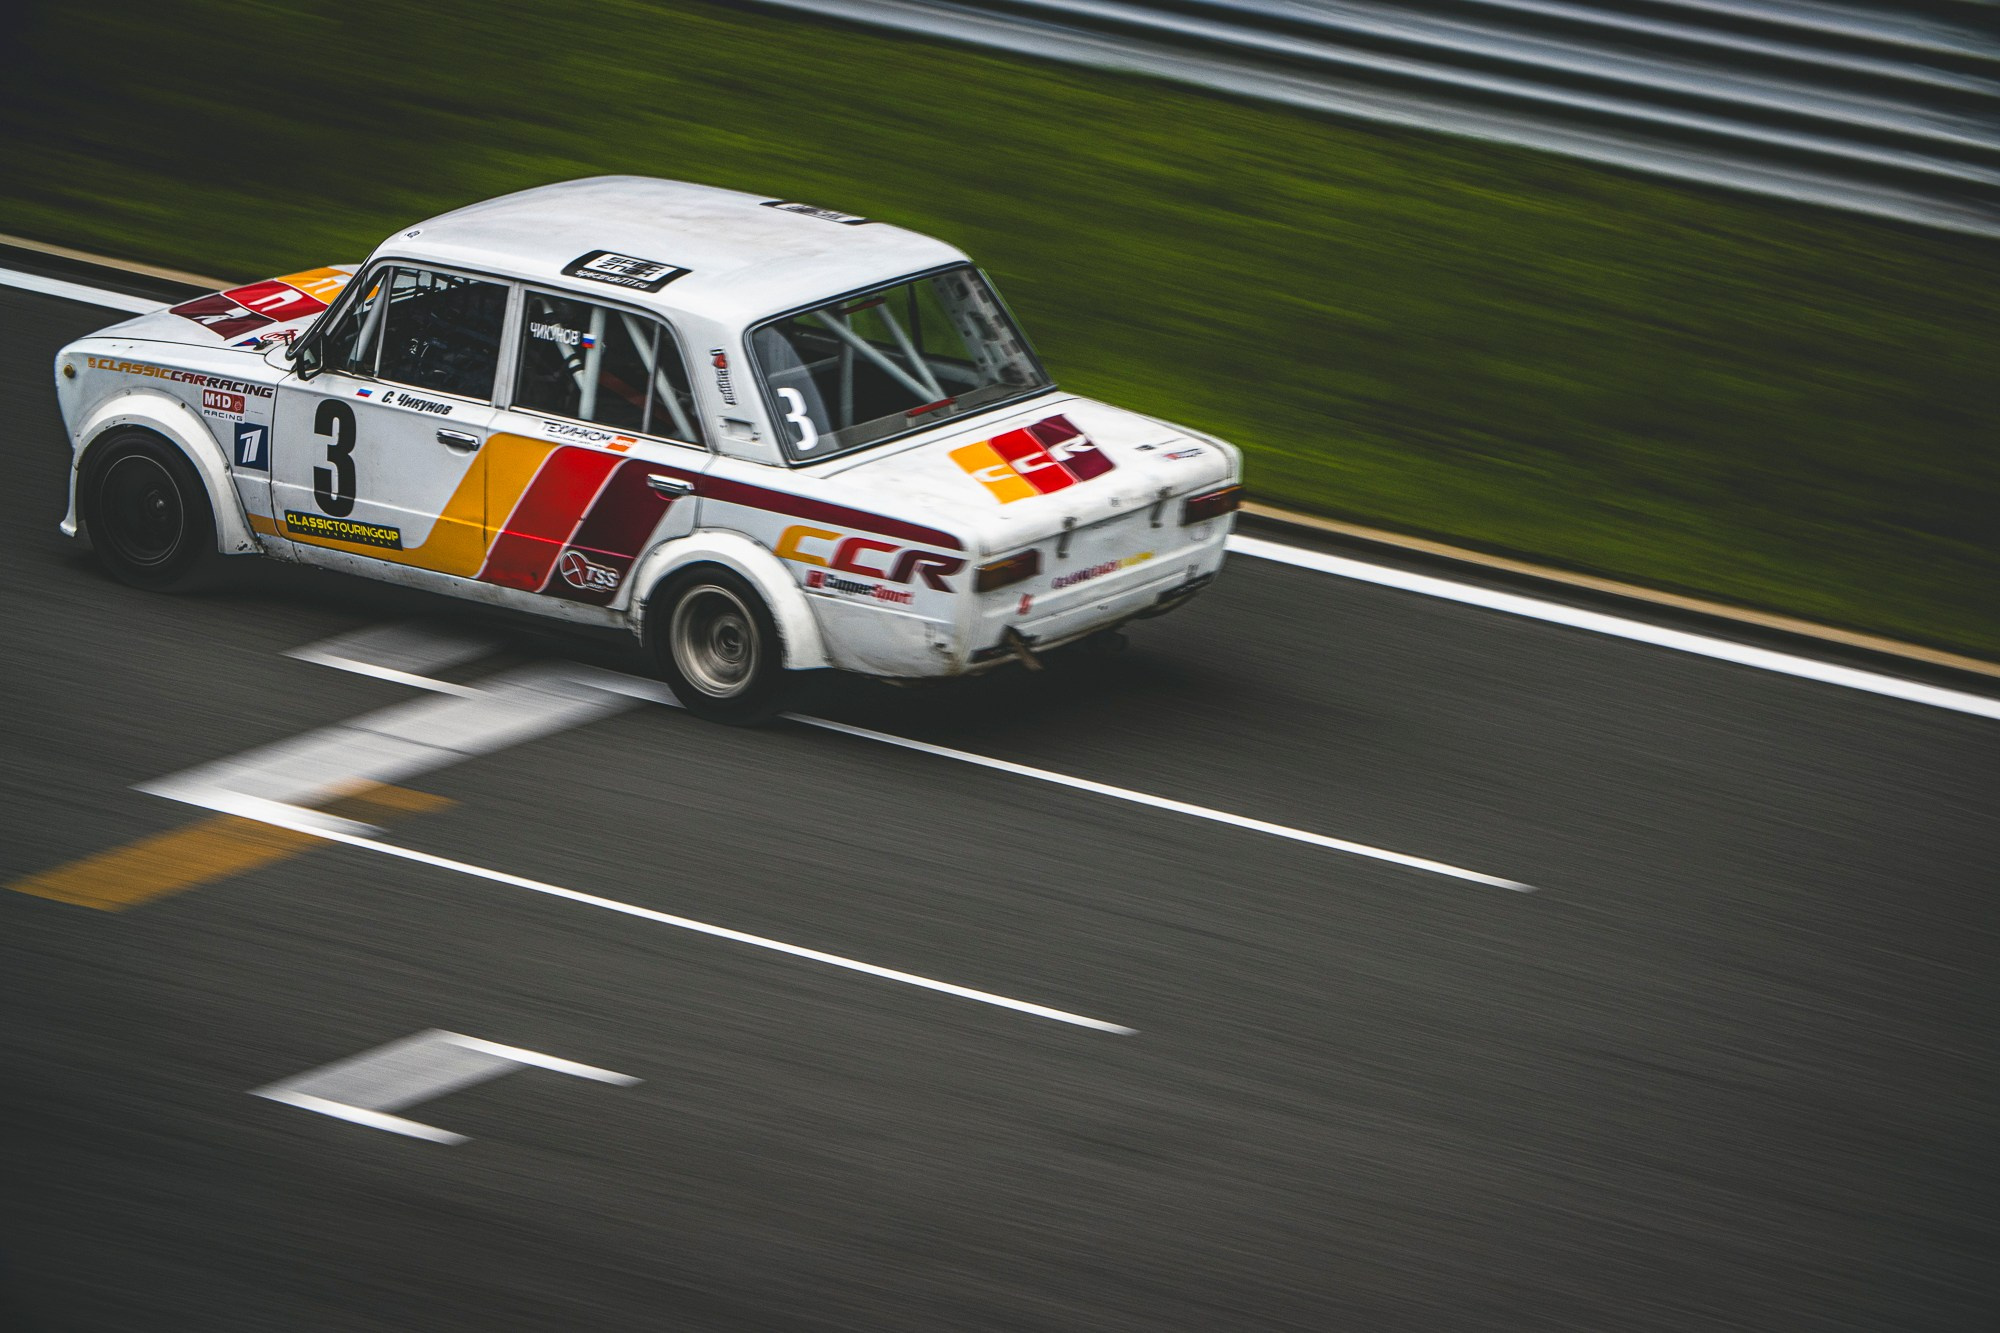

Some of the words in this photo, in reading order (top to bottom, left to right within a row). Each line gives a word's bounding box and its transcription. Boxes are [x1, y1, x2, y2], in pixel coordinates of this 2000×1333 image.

[530, 322, 581, 346] ЧИКУНОВ
[203, 409, 244, 422] RACING
[204, 392, 232, 410] M1D
[774, 387, 820, 452] 3
[313, 399, 357, 518] 3
[970, 432, 1099, 484] CCR
[585, 565, 620, 587] TSS
[773, 524, 970, 594] CCR
